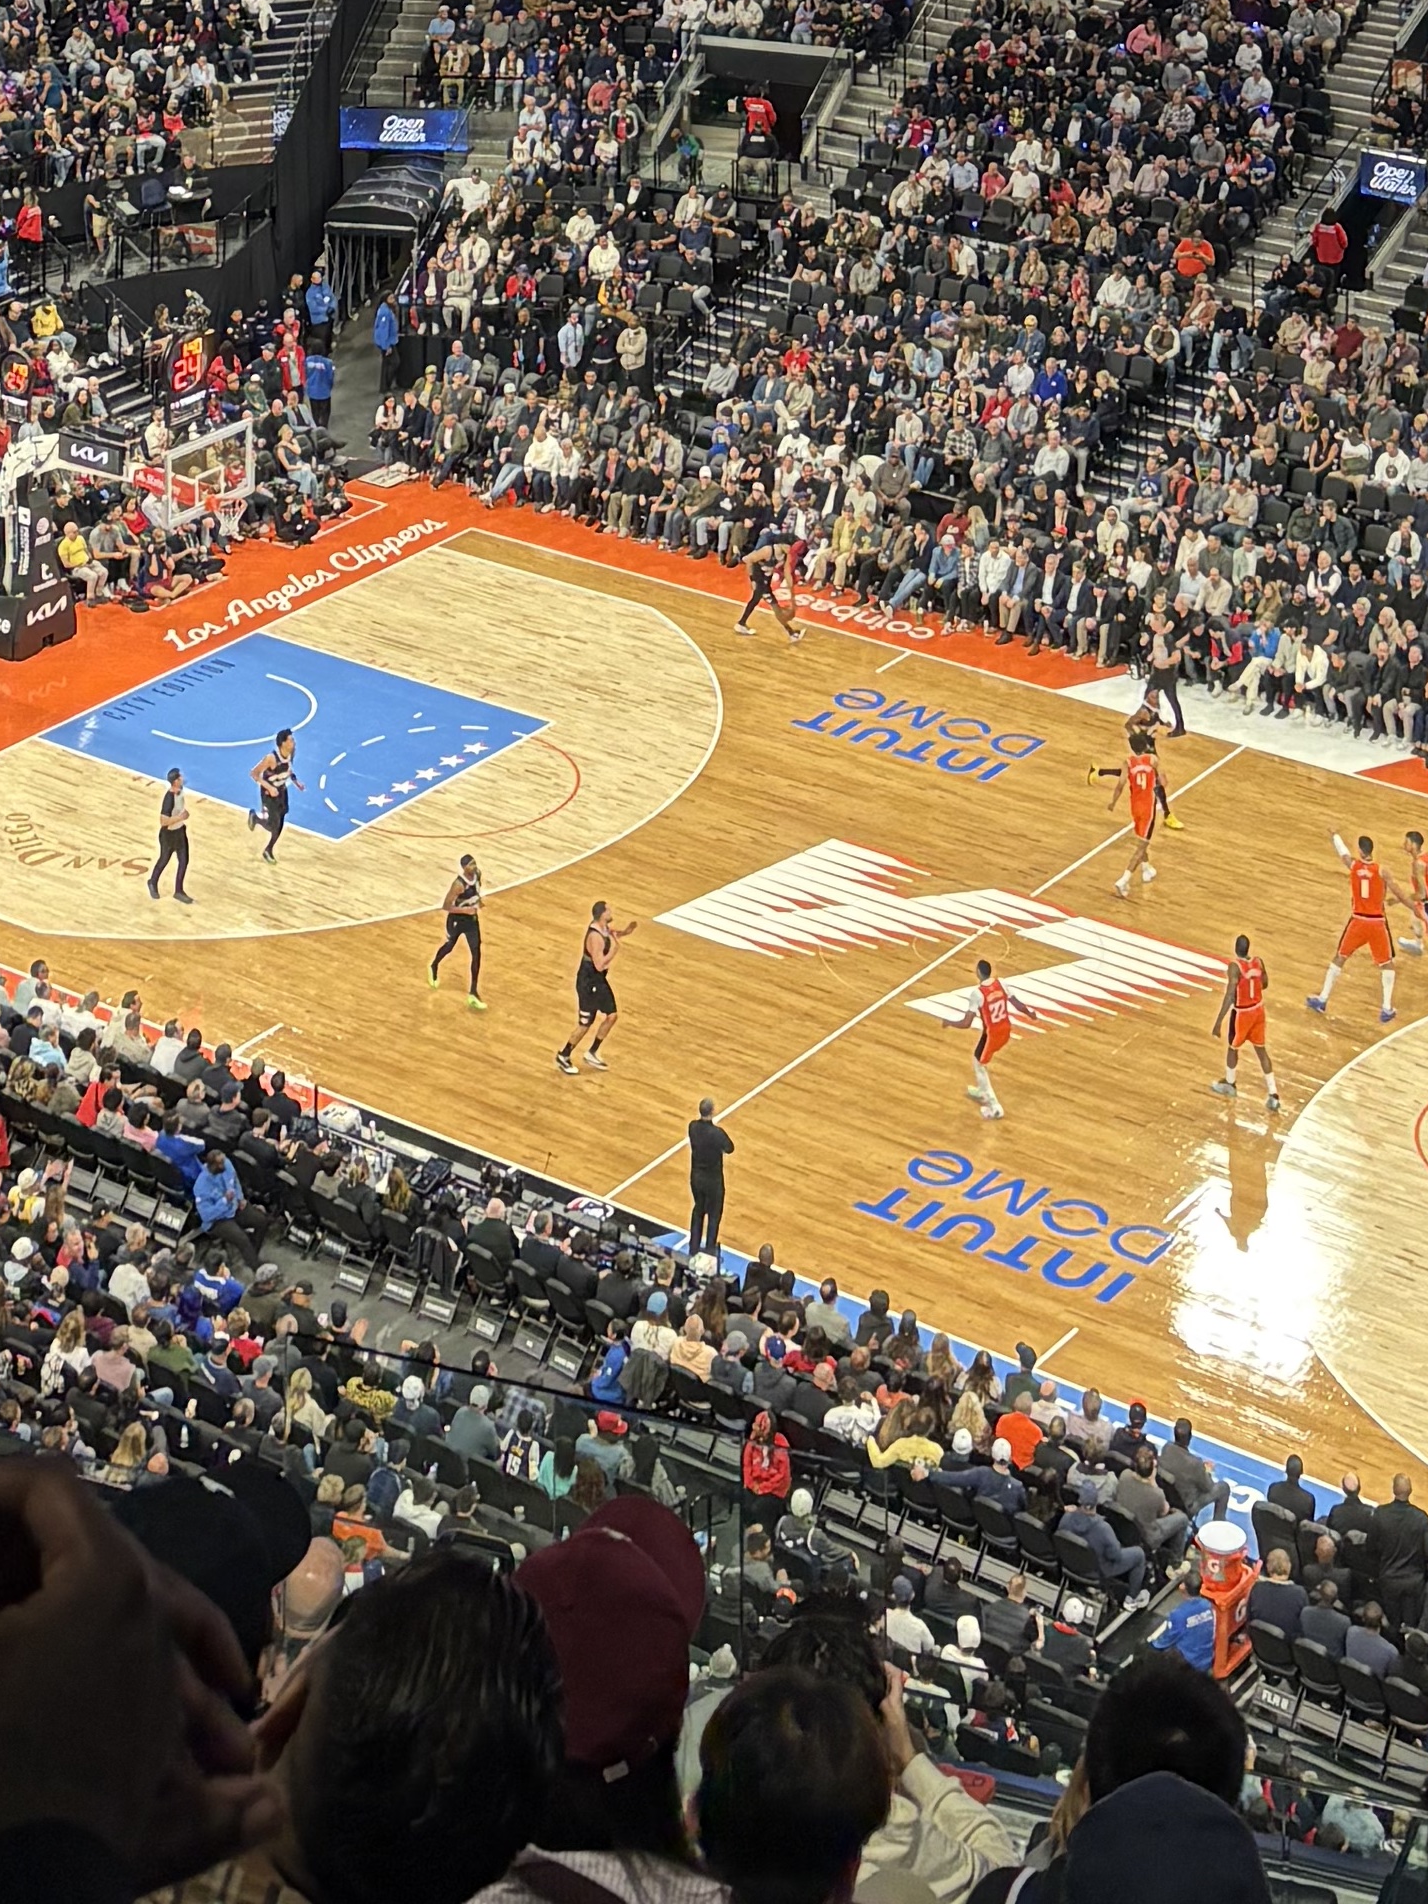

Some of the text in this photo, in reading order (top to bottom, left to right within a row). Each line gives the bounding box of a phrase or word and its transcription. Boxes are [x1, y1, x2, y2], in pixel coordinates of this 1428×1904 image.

[379, 115, 426, 142] Open Water
[174, 358, 201, 392] 24
[164, 517, 448, 652] Los Angeles Clippers
[103, 658, 236, 722] CITY EDITION
[4, 813, 152, 877] SAN DIEGO
[989, 1001, 1006, 1024] 22
